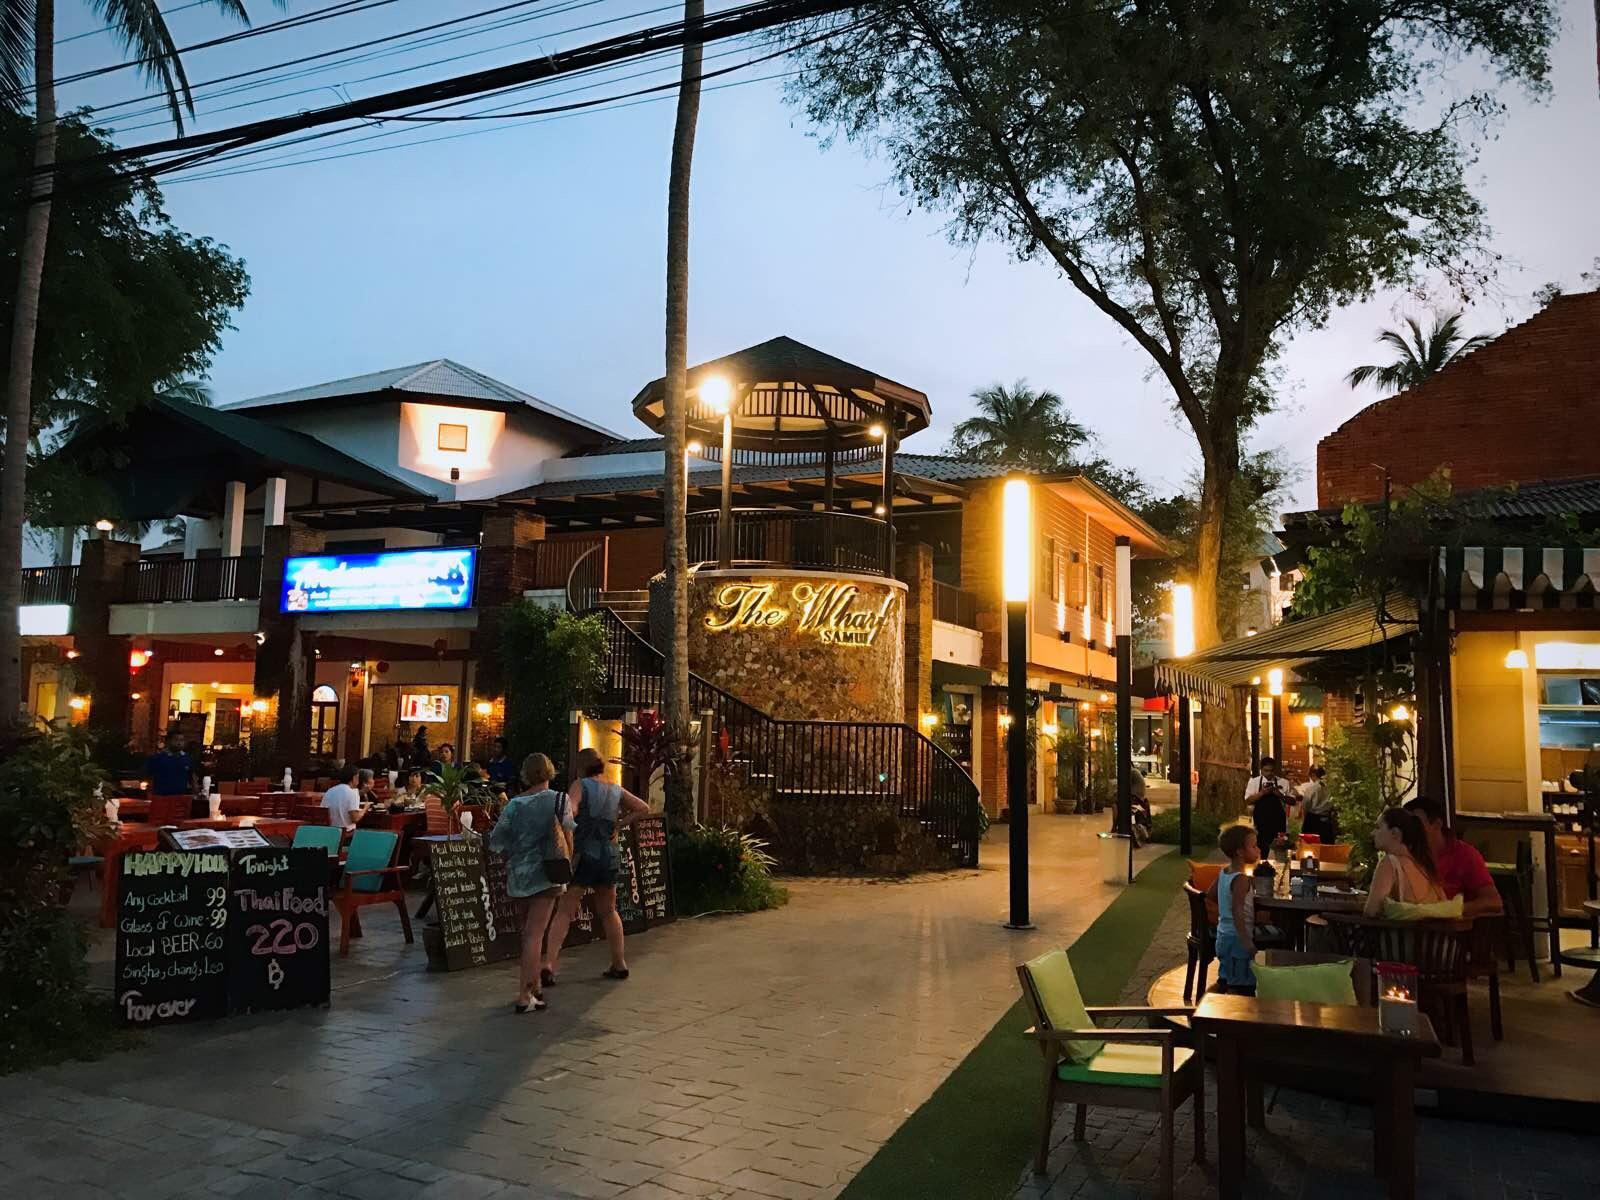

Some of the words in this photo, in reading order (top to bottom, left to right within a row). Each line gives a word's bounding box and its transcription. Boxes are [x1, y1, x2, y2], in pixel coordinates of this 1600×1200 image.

[705, 583, 785, 628] The
[793, 582, 896, 645] Wharf
[823, 631, 870, 644] SAMUI
[124, 852, 194, 877] HAPPY
[239, 854, 289, 877] Tonight
[124, 891, 145, 912] Any
[147, 884, 188, 907] Cocktail
[206, 886, 227, 907] 99
[234, 889, 280, 912] Thai
[282, 886, 328, 916] Food
[120, 918, 152, 934] Glass
[245, 919, 319, 955] 220
[125, 938, 155, 957] Local
